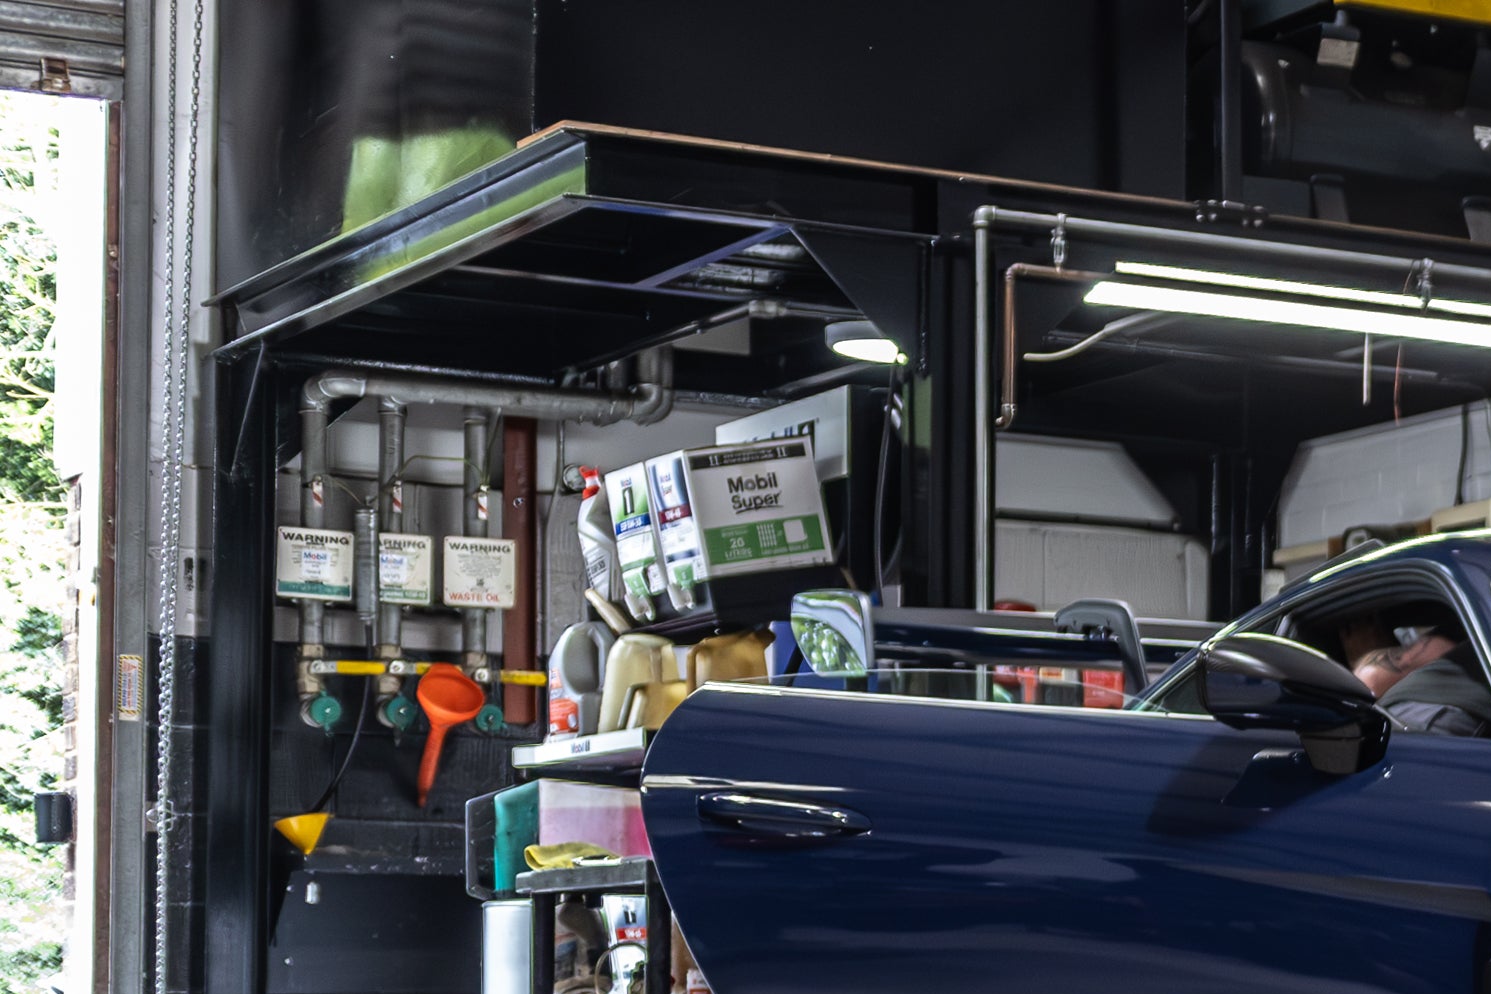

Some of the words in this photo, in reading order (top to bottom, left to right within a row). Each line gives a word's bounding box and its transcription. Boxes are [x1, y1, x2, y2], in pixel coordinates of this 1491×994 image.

[727, 472, 778, 493] Mobil
[731, 491, 782, 511] Super
[282, 532, 350, 545] WARNING
[379, 538, 427, 550] RNING
[730, 537, 745, 549] 20
[449, 542, 511, 554] WARNING
[303, 551, 328, 561] Mobil
[450, 592, 482, 601] WASTE
